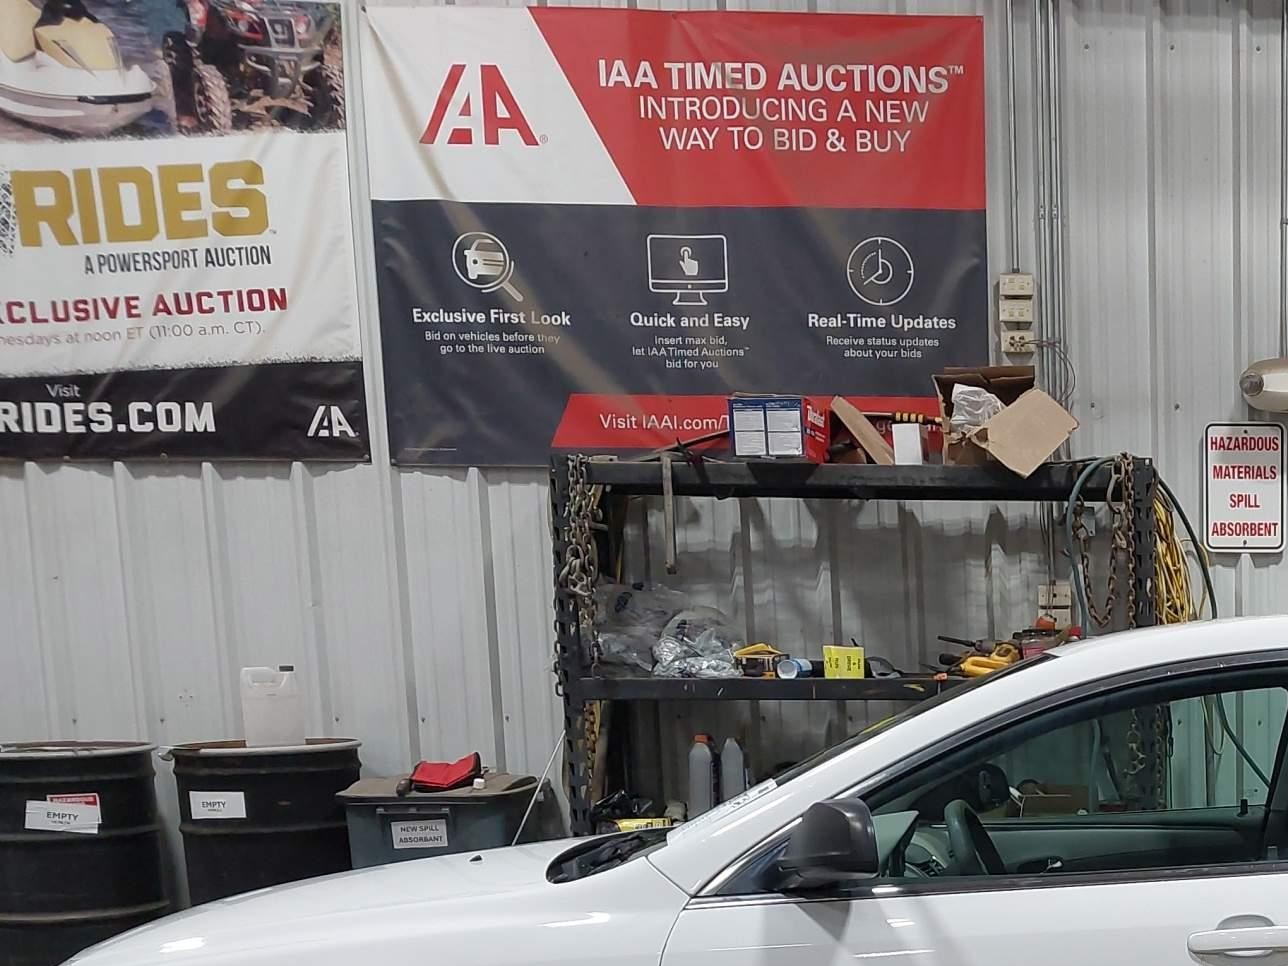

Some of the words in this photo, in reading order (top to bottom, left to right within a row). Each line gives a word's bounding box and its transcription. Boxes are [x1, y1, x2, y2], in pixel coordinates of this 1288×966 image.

[599, 59, 658, 90] IAA
[664, 61, 768, 91] TIMED
[639, 96, 828, 122] INTRODUCING
[836, 99, 857, 122] A
[865, 100, 930, 123] NEW
[659, 126, 720, 151] WAY
[727, 126, 764, 151] TO
[773, 128, 817, 152] BID
[825, 128, 847, 153] &
[856, 129, 912, 153] BUY
[84, 255, 95, 275] A
[98, 248, 199, 274] POWERSPORT
[204, 245, 273, 269] AUCTION
[152, 286, 289, 317] AUCTION
[412, 308, 486, 324] Exclusive
[490, 308, 527, 324] First
[530, 310, 572, 327] Look
[630, 312, 677, 327] Quick
[680, 313, 709, 327] and
[713, 313, 750, 330] Easy
[807, 313, 887, 329] Real-Time
[890, 314, 957, 332] Updates
[65, 332, 80, 344] at
[83, 331, 122, 343] noon
[126, 327, 144, 341] ET
[149, 323, 194, 340] (11:00
[198, 324, 229, 337] a.m.
[234, 321, 267, 335] CT).
[425, 331, 441, 341] Bid
[443, 333, 456, 342] on
[458, 331, 501, 342] vehicles
[502, 332, 535, 343] before
[536, 333, 561, 345] they
[654, 335, 683, 346] Insert
[685, 336, 706, 346] max
[709, 335, 728, 347] bid,
[826, 335, 865, 346] Receive
[866, 336, 897, 347] status
[899, 337, 940, 348] updates
[440, 345, 453, 355] go
[455, 344, 466, 353] to
[467, 344, 485, 354] the
[487, 344, 506, 354] live
[508, 344, 545, 354] auction
[632, 346, 646, 356] let
[648, 346, 667, 357] IAA
[668, 347, 699, 357] Timed
[844, 348, 873, 359] about
[875, 350, 898, 360] your
[900, 348, 922, 359] bids
[665, 359, 682, 369] bid
[684, 359, 699, 369] for
[700, 360, 719, 371] you
[45, 383, 81, 398] Visit
[599, 413, 638, 430] Visit
[1210, 436, 1280, 452] HAZARDOUS
[1212, 465, 1278, 481] MATERIALS
[1229, 493, 1261, 509] SPILL
[1211, 522, 1279, 537] ABSORBENT
[46, 811, 79, 821] EMPTY
[400, 825, 418, 833] NEW
